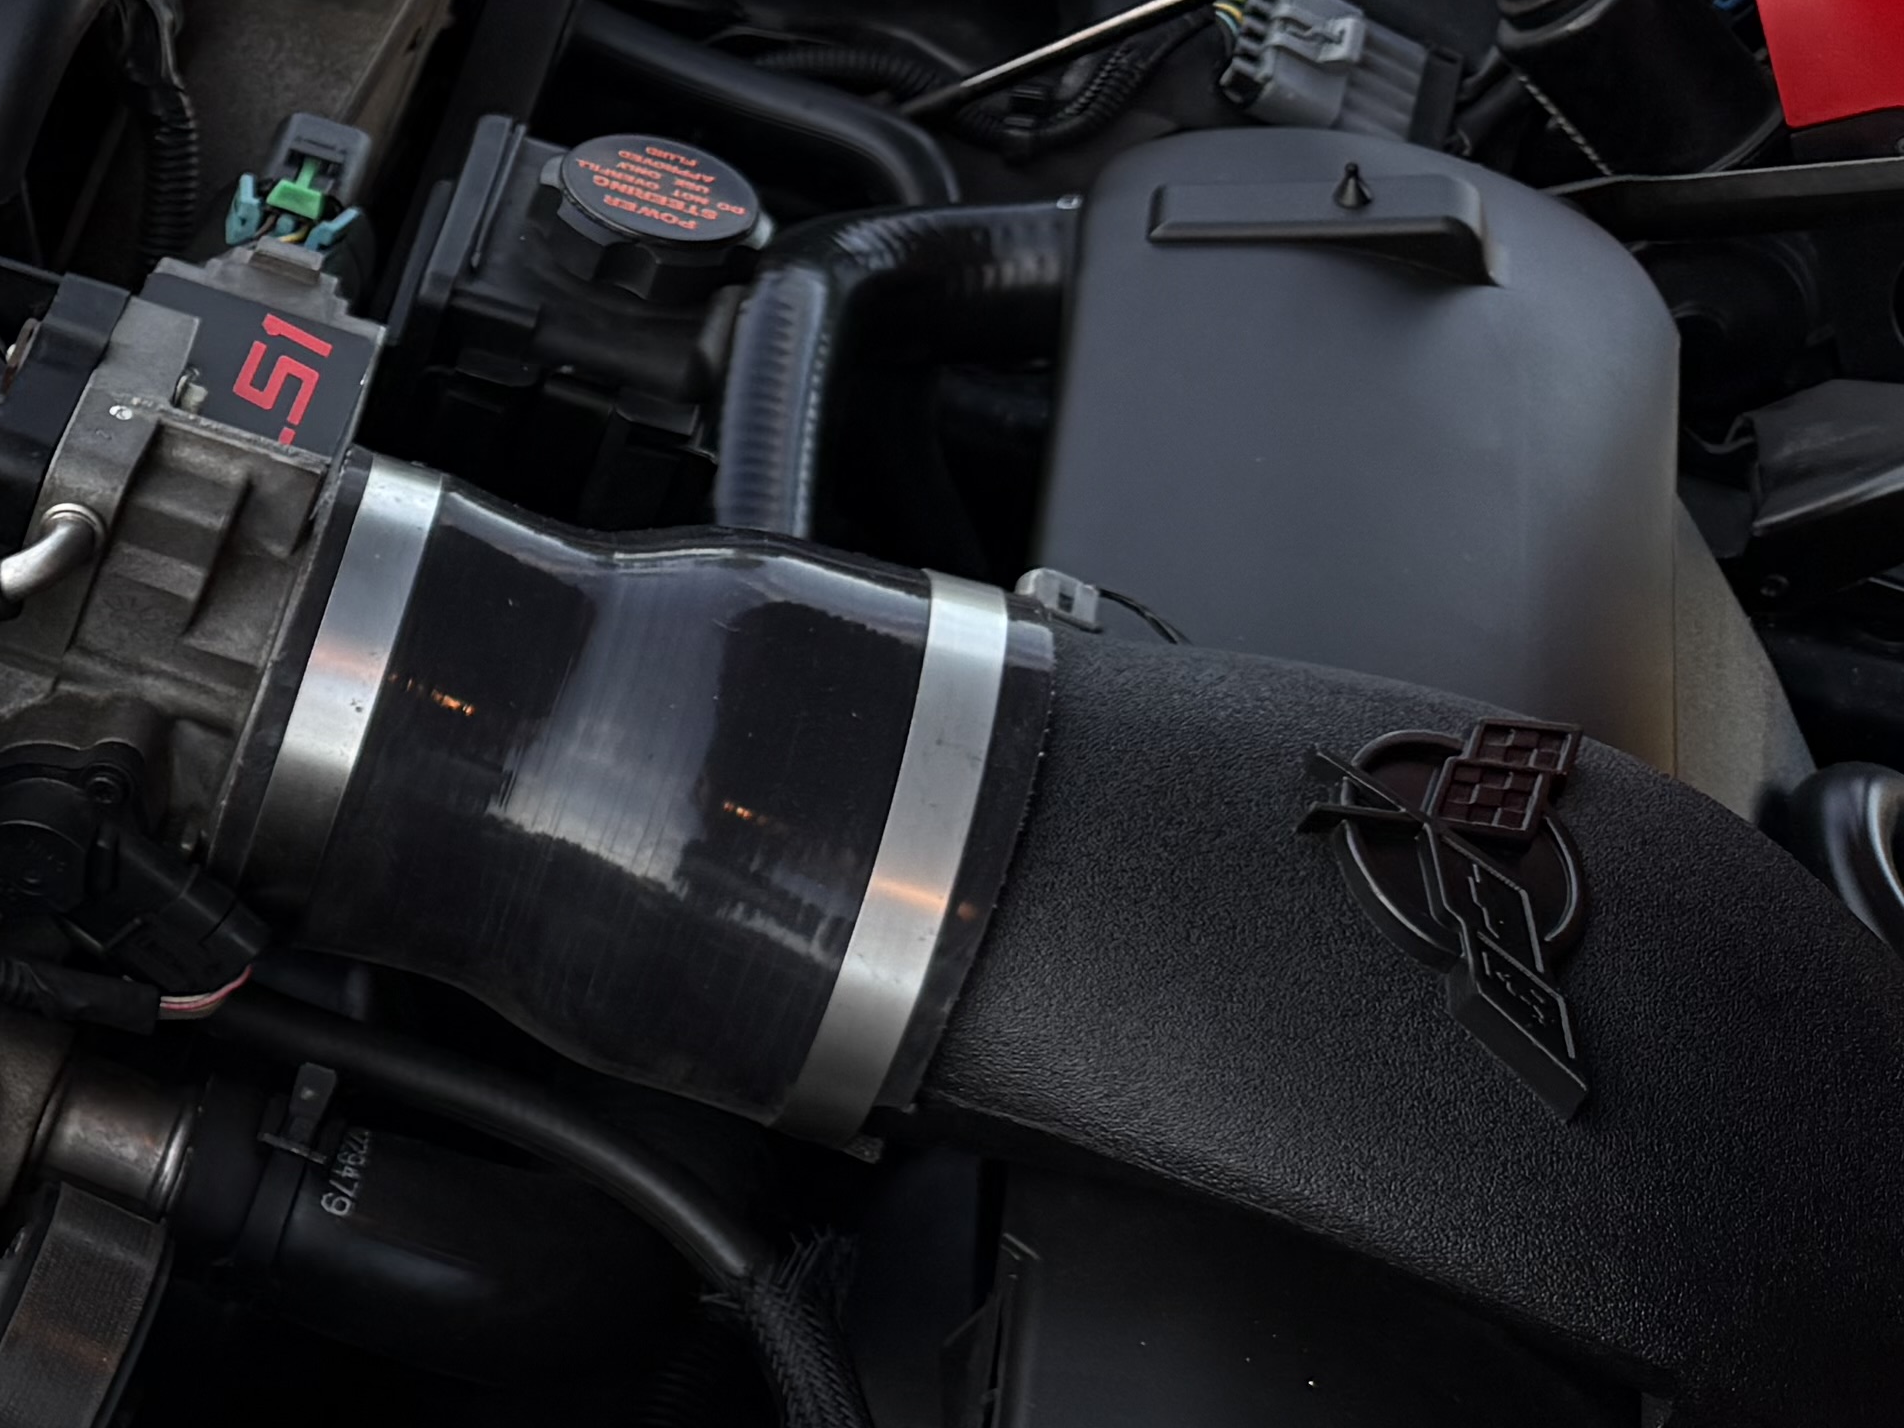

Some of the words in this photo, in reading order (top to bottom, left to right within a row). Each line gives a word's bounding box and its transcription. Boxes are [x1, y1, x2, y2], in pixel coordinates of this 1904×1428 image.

[616, 161, 663, 181] ONLY
[617, 149, 717, 184] APPROVED
[645, 145, 700, 167] FLUID
[575, 158, 661, 191] OVERFILL
[591, 174, 719, 221] STEERING
[603, 194, 699, 231] POWER
[673, 188, 712, 206] NOT
[717, 201, 746, 216] DO
[232, 313, 334, 445] S1
